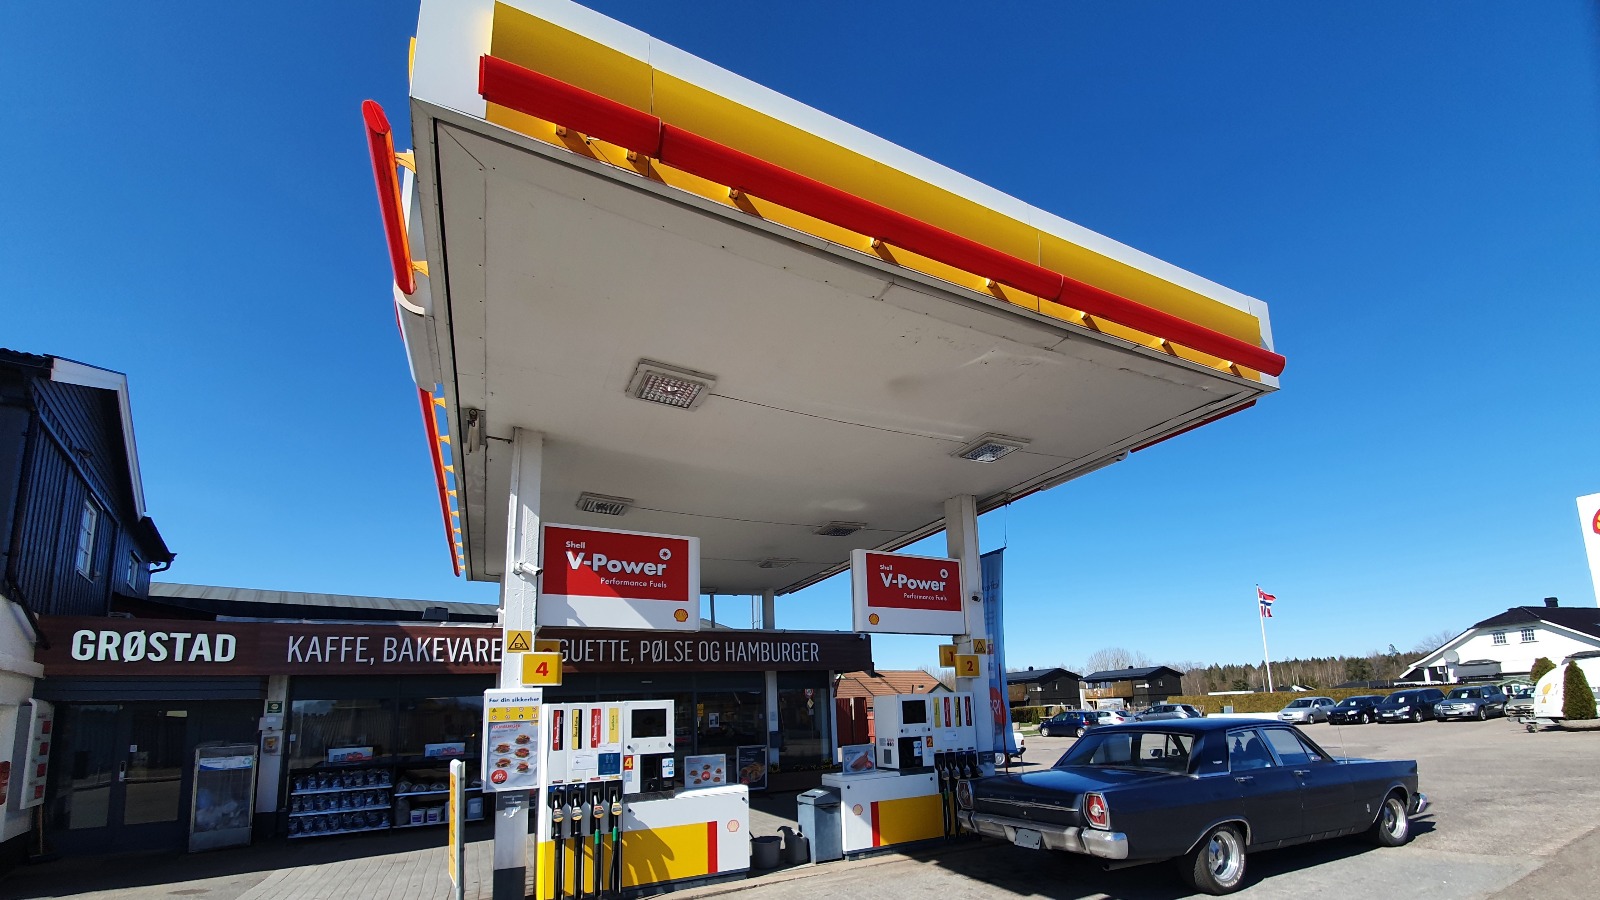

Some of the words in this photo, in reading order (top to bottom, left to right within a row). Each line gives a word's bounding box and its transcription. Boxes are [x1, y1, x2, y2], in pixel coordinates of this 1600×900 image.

[565, 540, 586, 549] Shell
[565, 550, 667, 576] V-Power
[600, 577, 648, 587] Performance
[649, 580, 668, 589] Fuels
[880, 572, 946, 592] V-Power
[903, 592, 935, 601] Performance
[71, 629, 237, 662] GRØSTAD
[287, 635, 376, 666] KAFFE,
[640, 639, 694, 663] PØLSE
[698, 640, 720, 663] OG
[725, 641, 820, 663] HAMBURGER
[949, 651, 954, 662] 1
[535, 661, 549, 677] 4
[966, 660, 974, 672] 2
[926, 736, 933, 747] 2
[624, 757, 633, 769] 4
